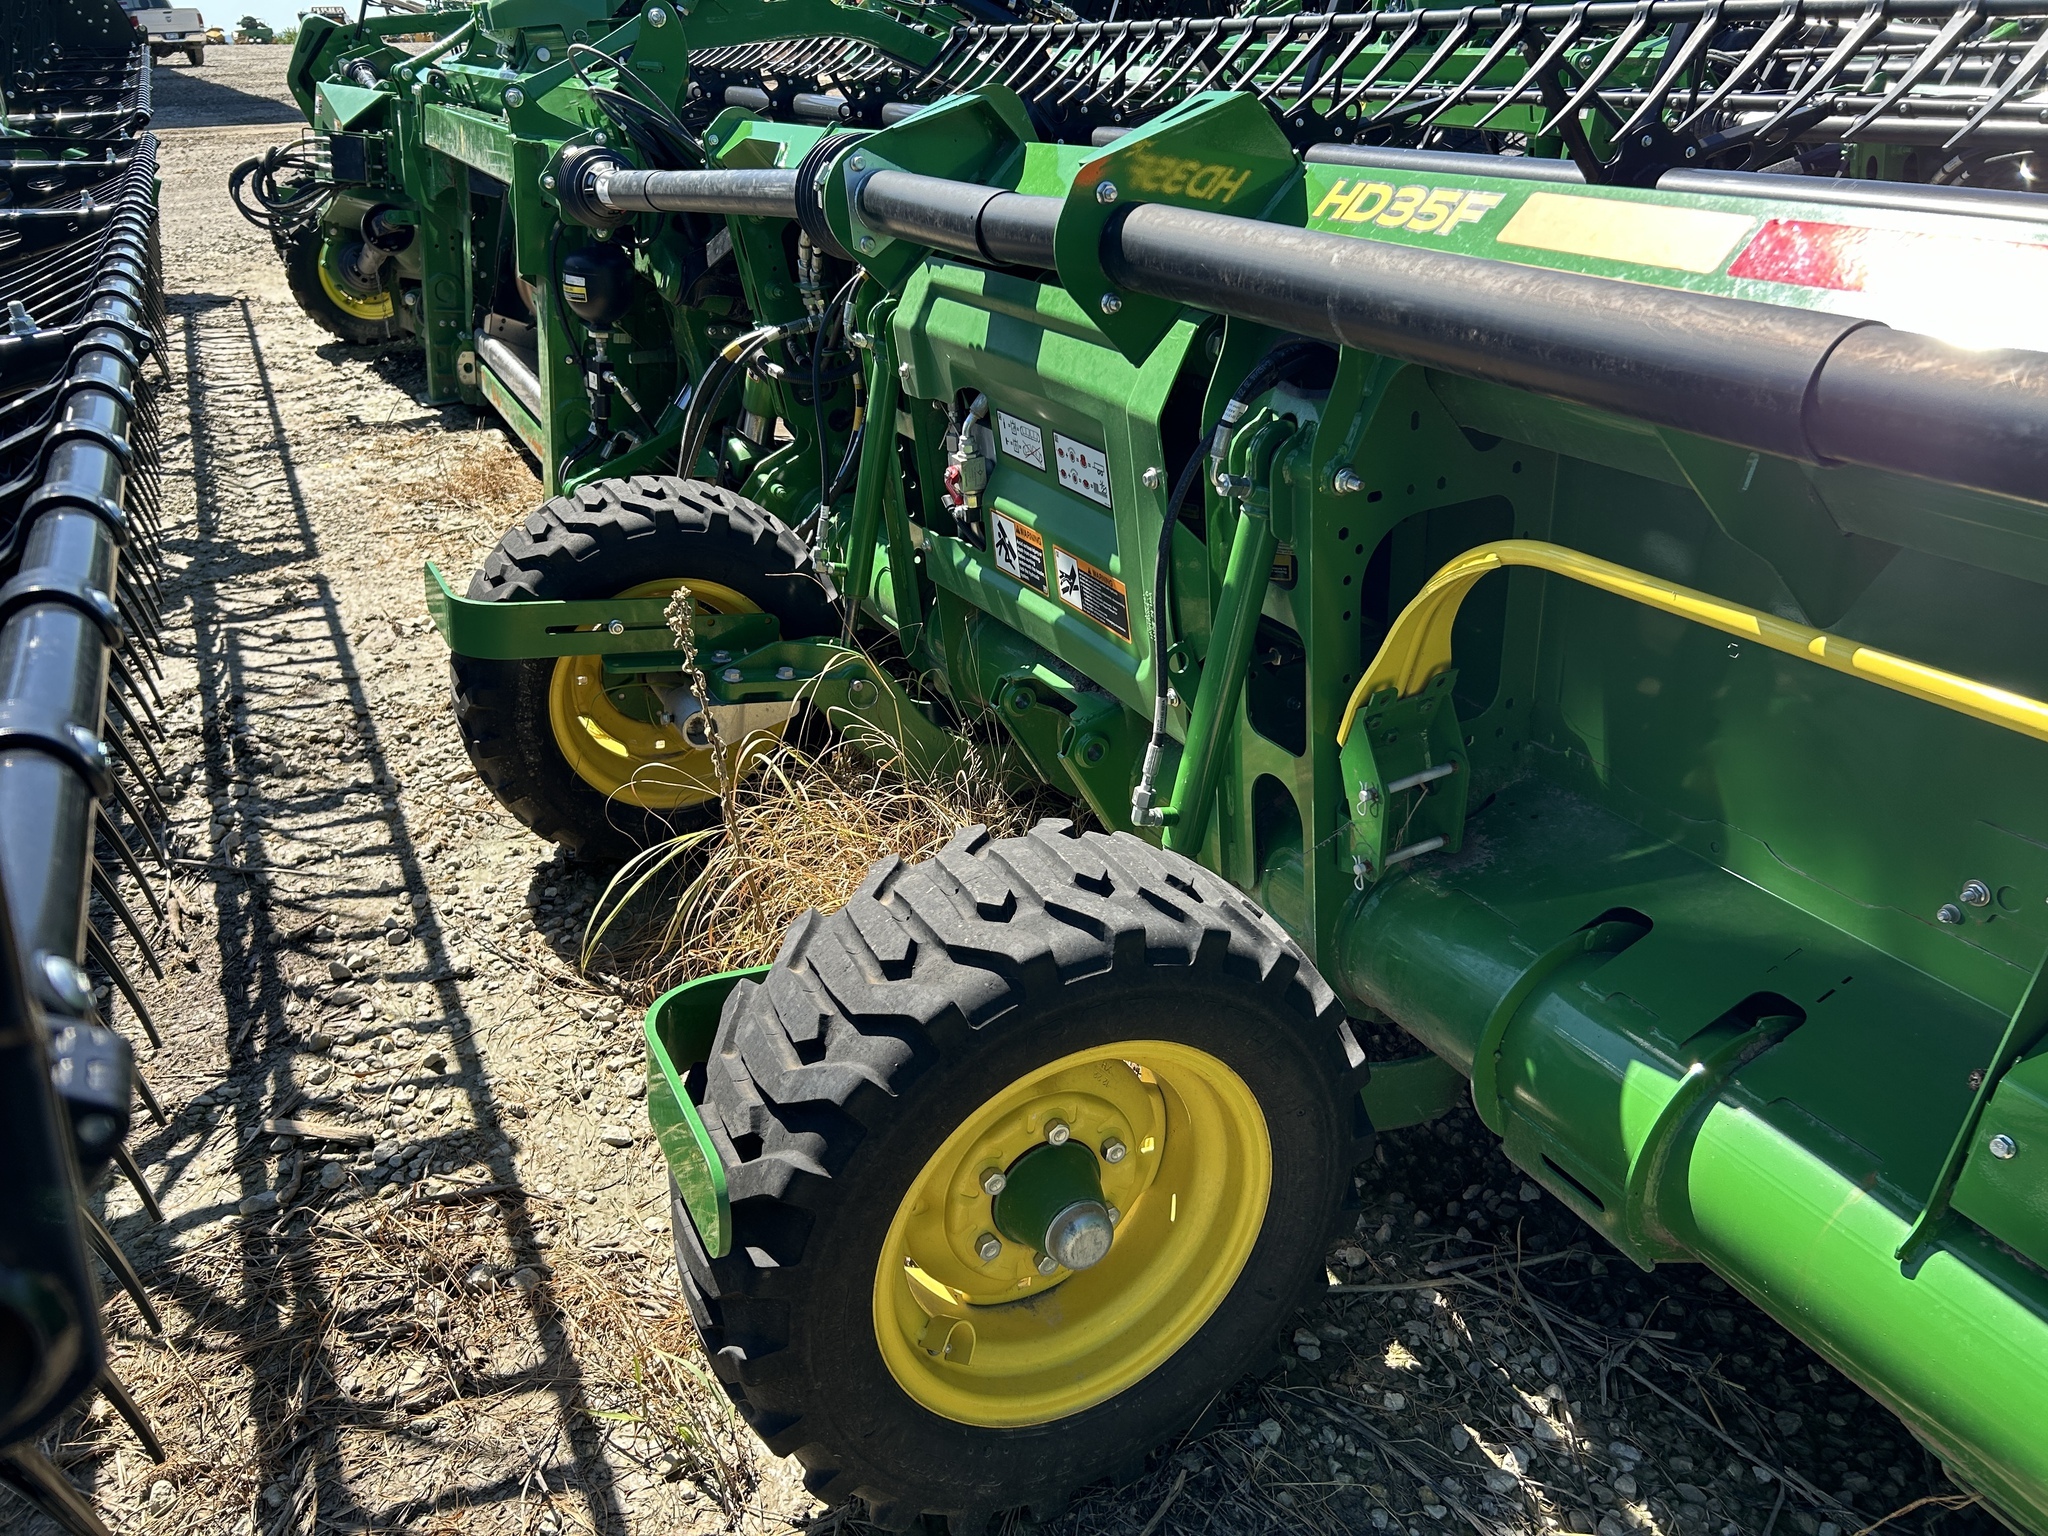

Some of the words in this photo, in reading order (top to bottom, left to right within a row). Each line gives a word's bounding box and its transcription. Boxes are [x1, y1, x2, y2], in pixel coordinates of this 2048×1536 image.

[1311, 177, 1506, 236] HD35F
[1019, 527, 1042, 546] WARNING
[1092, 571, 1113, 588] WARNING
